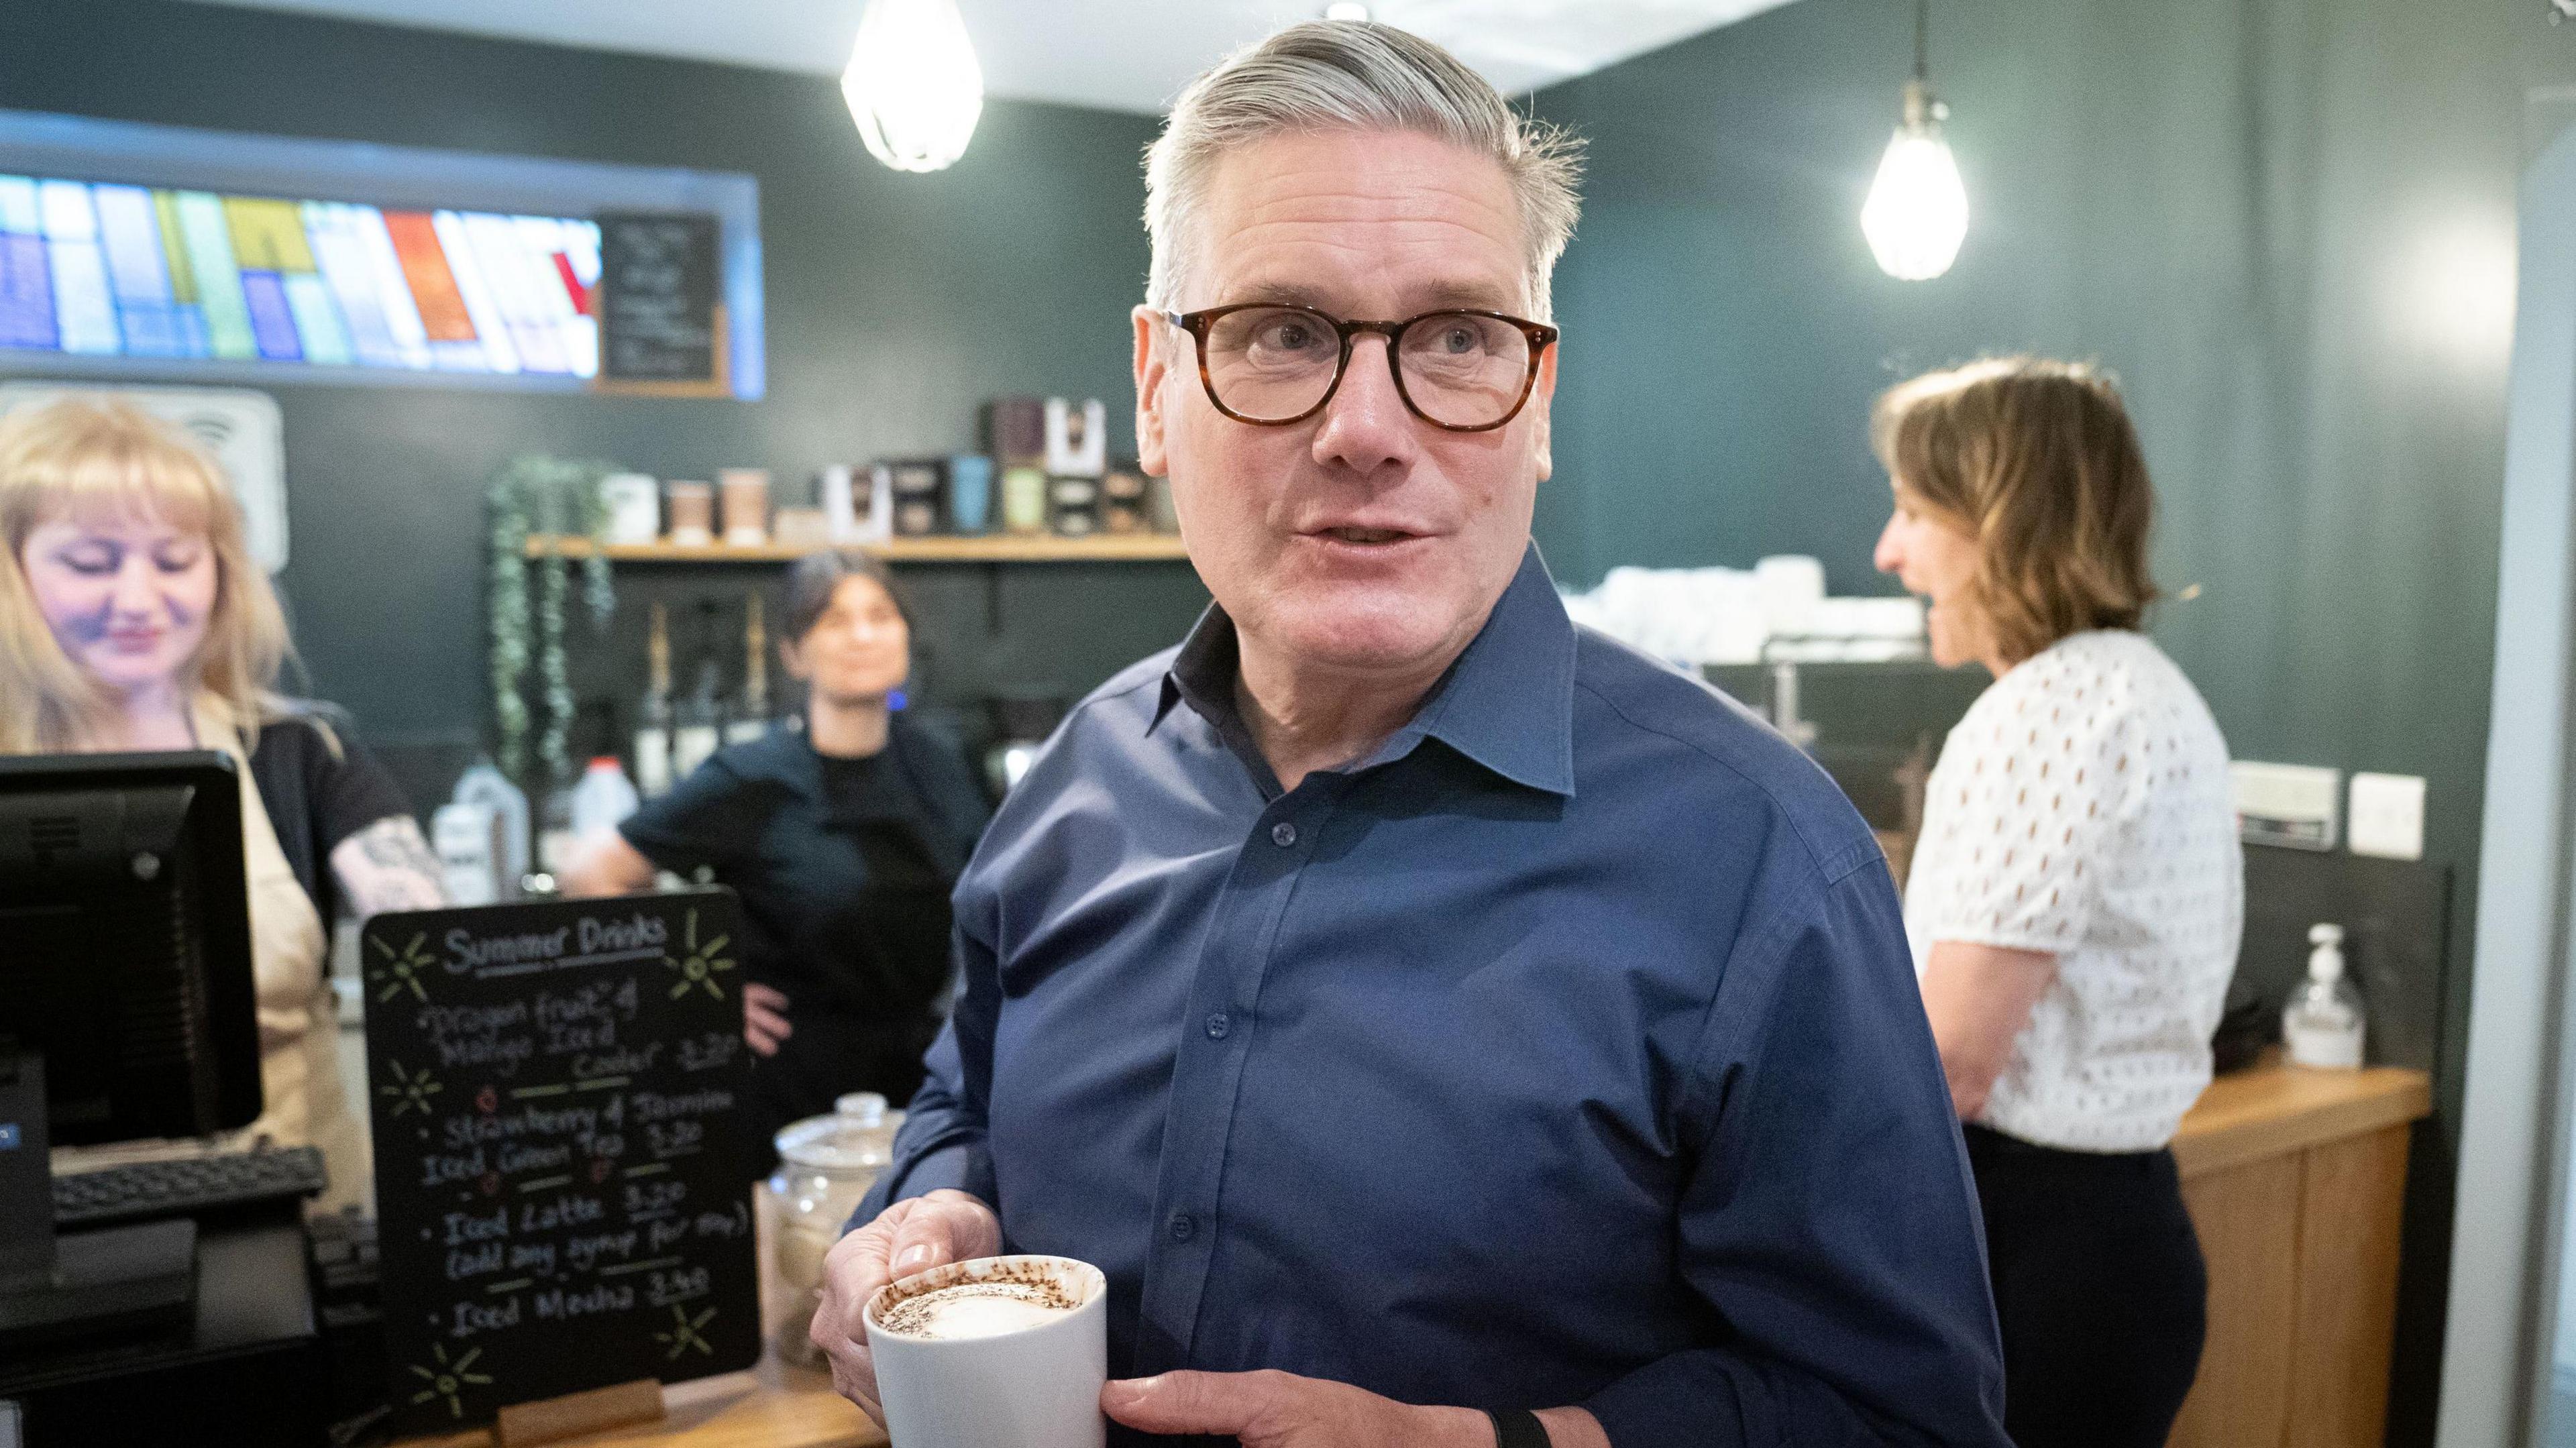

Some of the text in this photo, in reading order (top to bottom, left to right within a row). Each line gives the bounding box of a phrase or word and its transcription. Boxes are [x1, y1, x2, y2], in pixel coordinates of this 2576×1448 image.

[441, 911, 669, 975] Summer Drinks
[425, 999, 528, 1044] Dragon
[535, 982, 612, 1032] fruit
[437, 1017, 615, 1077] Mango Iced
[572, 1040, 664, 1076] Cooler
[443, 1105, 597, 1150] Strawberry
[631, 1088, 734, 1123] Jasmine
[421, 1146, 486, 1186] Iced
[496, 1141, 571, 1174] Green
[577, 1131, 625, 1157] Tea
[443, 1205, 510, 1245] Iced
[520, 1193, 605, 1232] Latte
[445, 1241, 503, 1281] (add
[509, 1242, 555, 1277] any
[566, 1230, 637, 1272] syrup
[649, 1217, 690, 1252] for
[449, 1296, 520, 1338] Iced
[535, 1283, 634, 1321] Mocha
